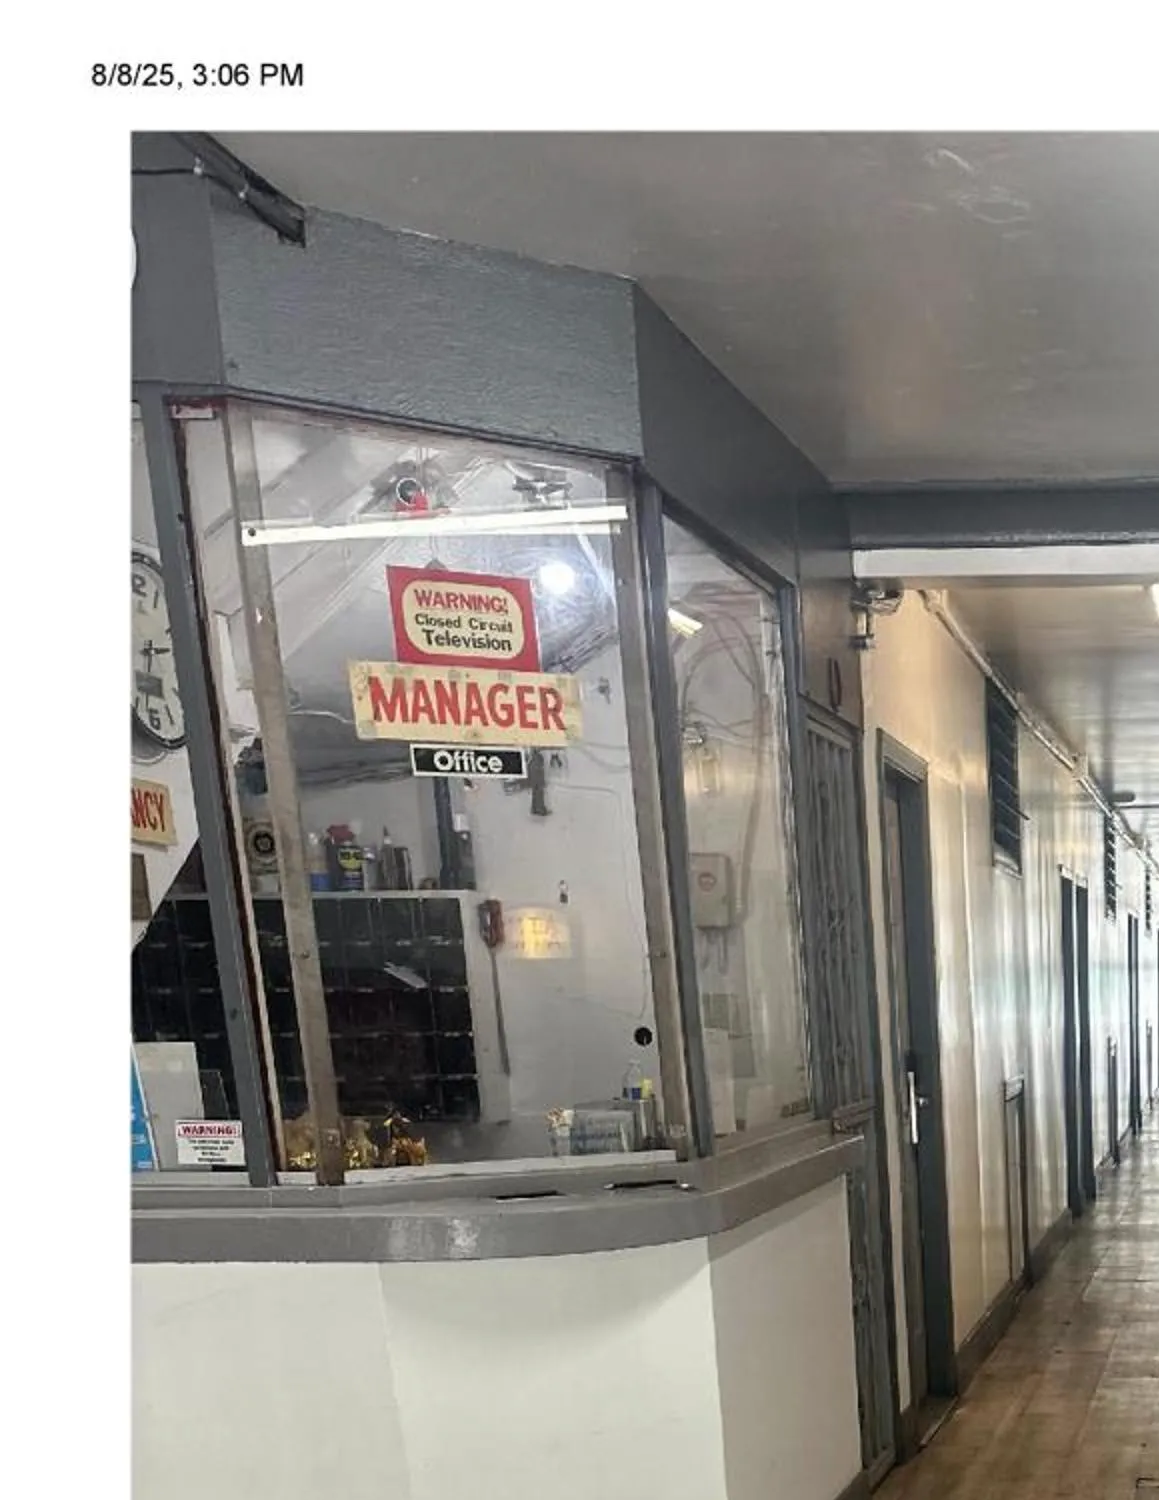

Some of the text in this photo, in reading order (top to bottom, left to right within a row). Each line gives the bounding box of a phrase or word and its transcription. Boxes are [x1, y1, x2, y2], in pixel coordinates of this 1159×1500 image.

[413, 588, 510, 615] WARNING!
[414, 612, 514, 634] Closed Circuit
[422, 628, 513, 652] Television
[367, 674, 568, 732] MANAGER
[432, 749, 504, 774] Office
